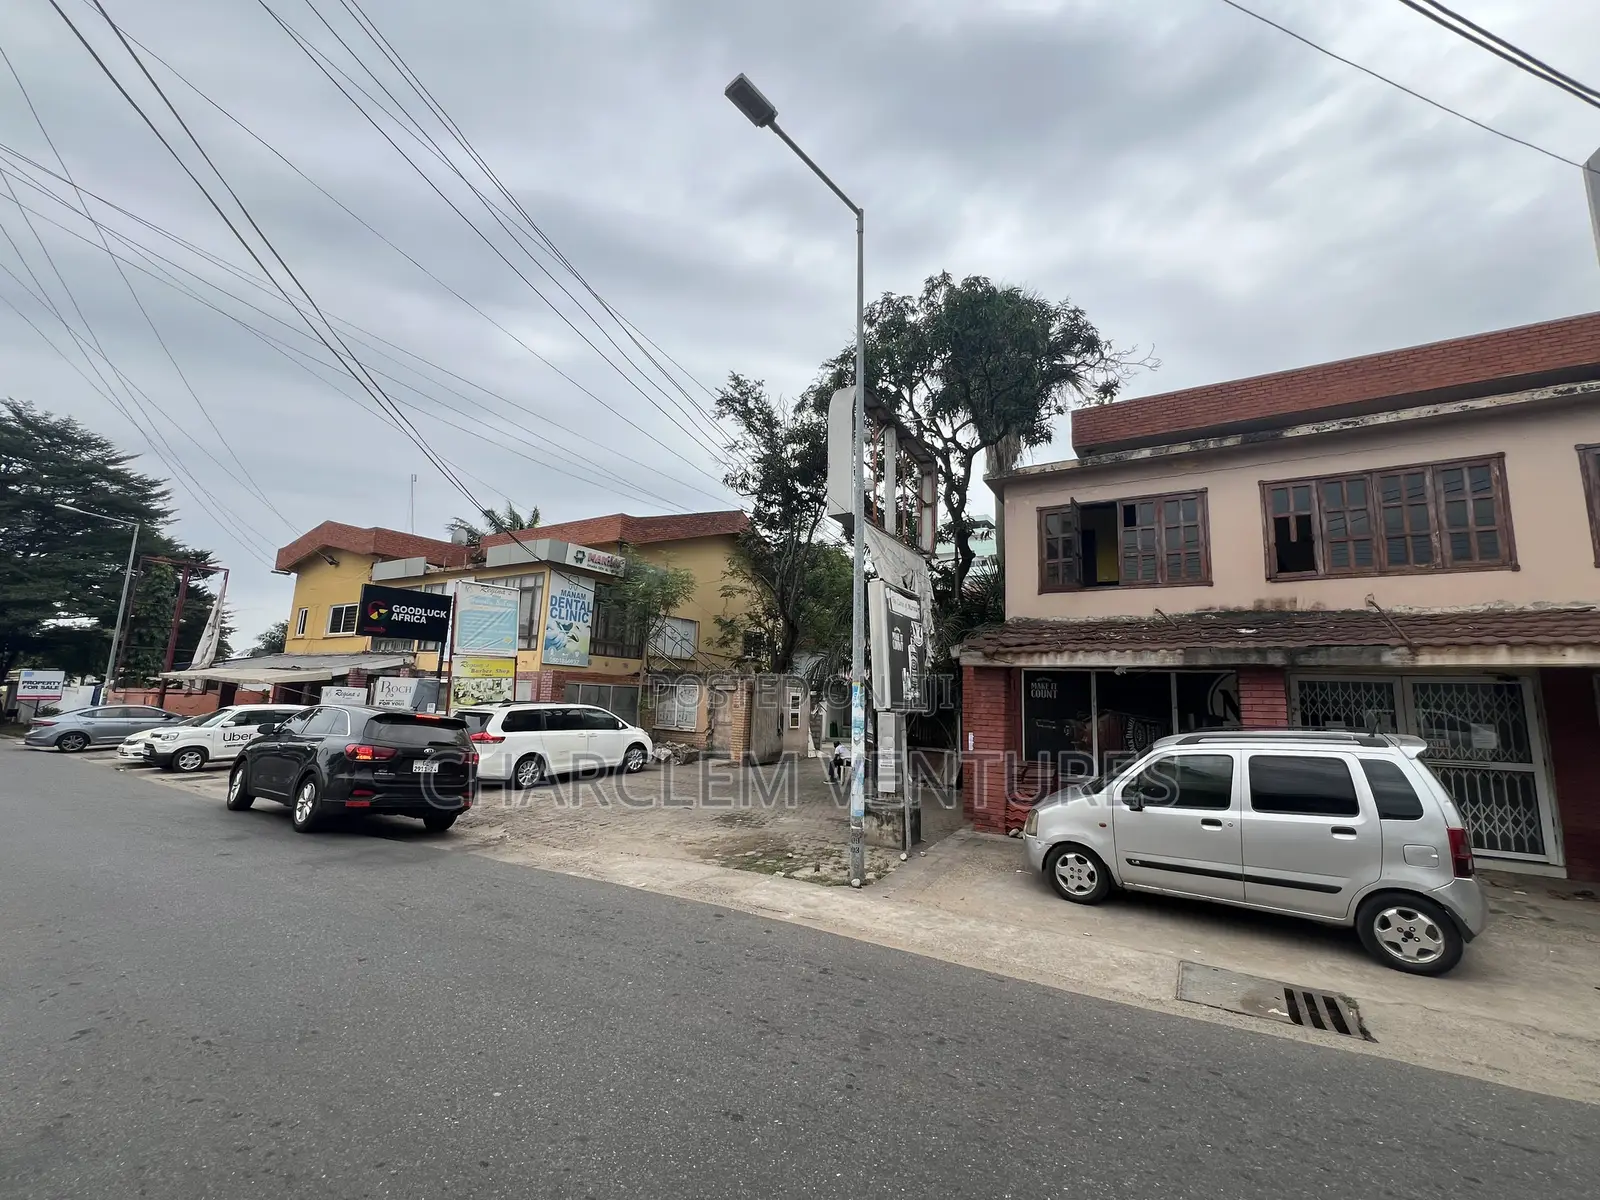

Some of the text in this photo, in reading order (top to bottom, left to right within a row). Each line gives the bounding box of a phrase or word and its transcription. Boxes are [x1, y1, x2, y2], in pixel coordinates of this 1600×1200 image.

[560, 589, 587, 600] MANAM
[550, 595, 593, 613] DENTAL
[392, 604, 447, 619] GOODLUCK
[550, 606, 589, 623] CLINIC
[391, 613, 427, 624] AFRICA
[1030, 682, 1058, 690] MAKE IT
[1030, 689, 1058, 699] COUNT
[222, 732, 253, 742] Uber
